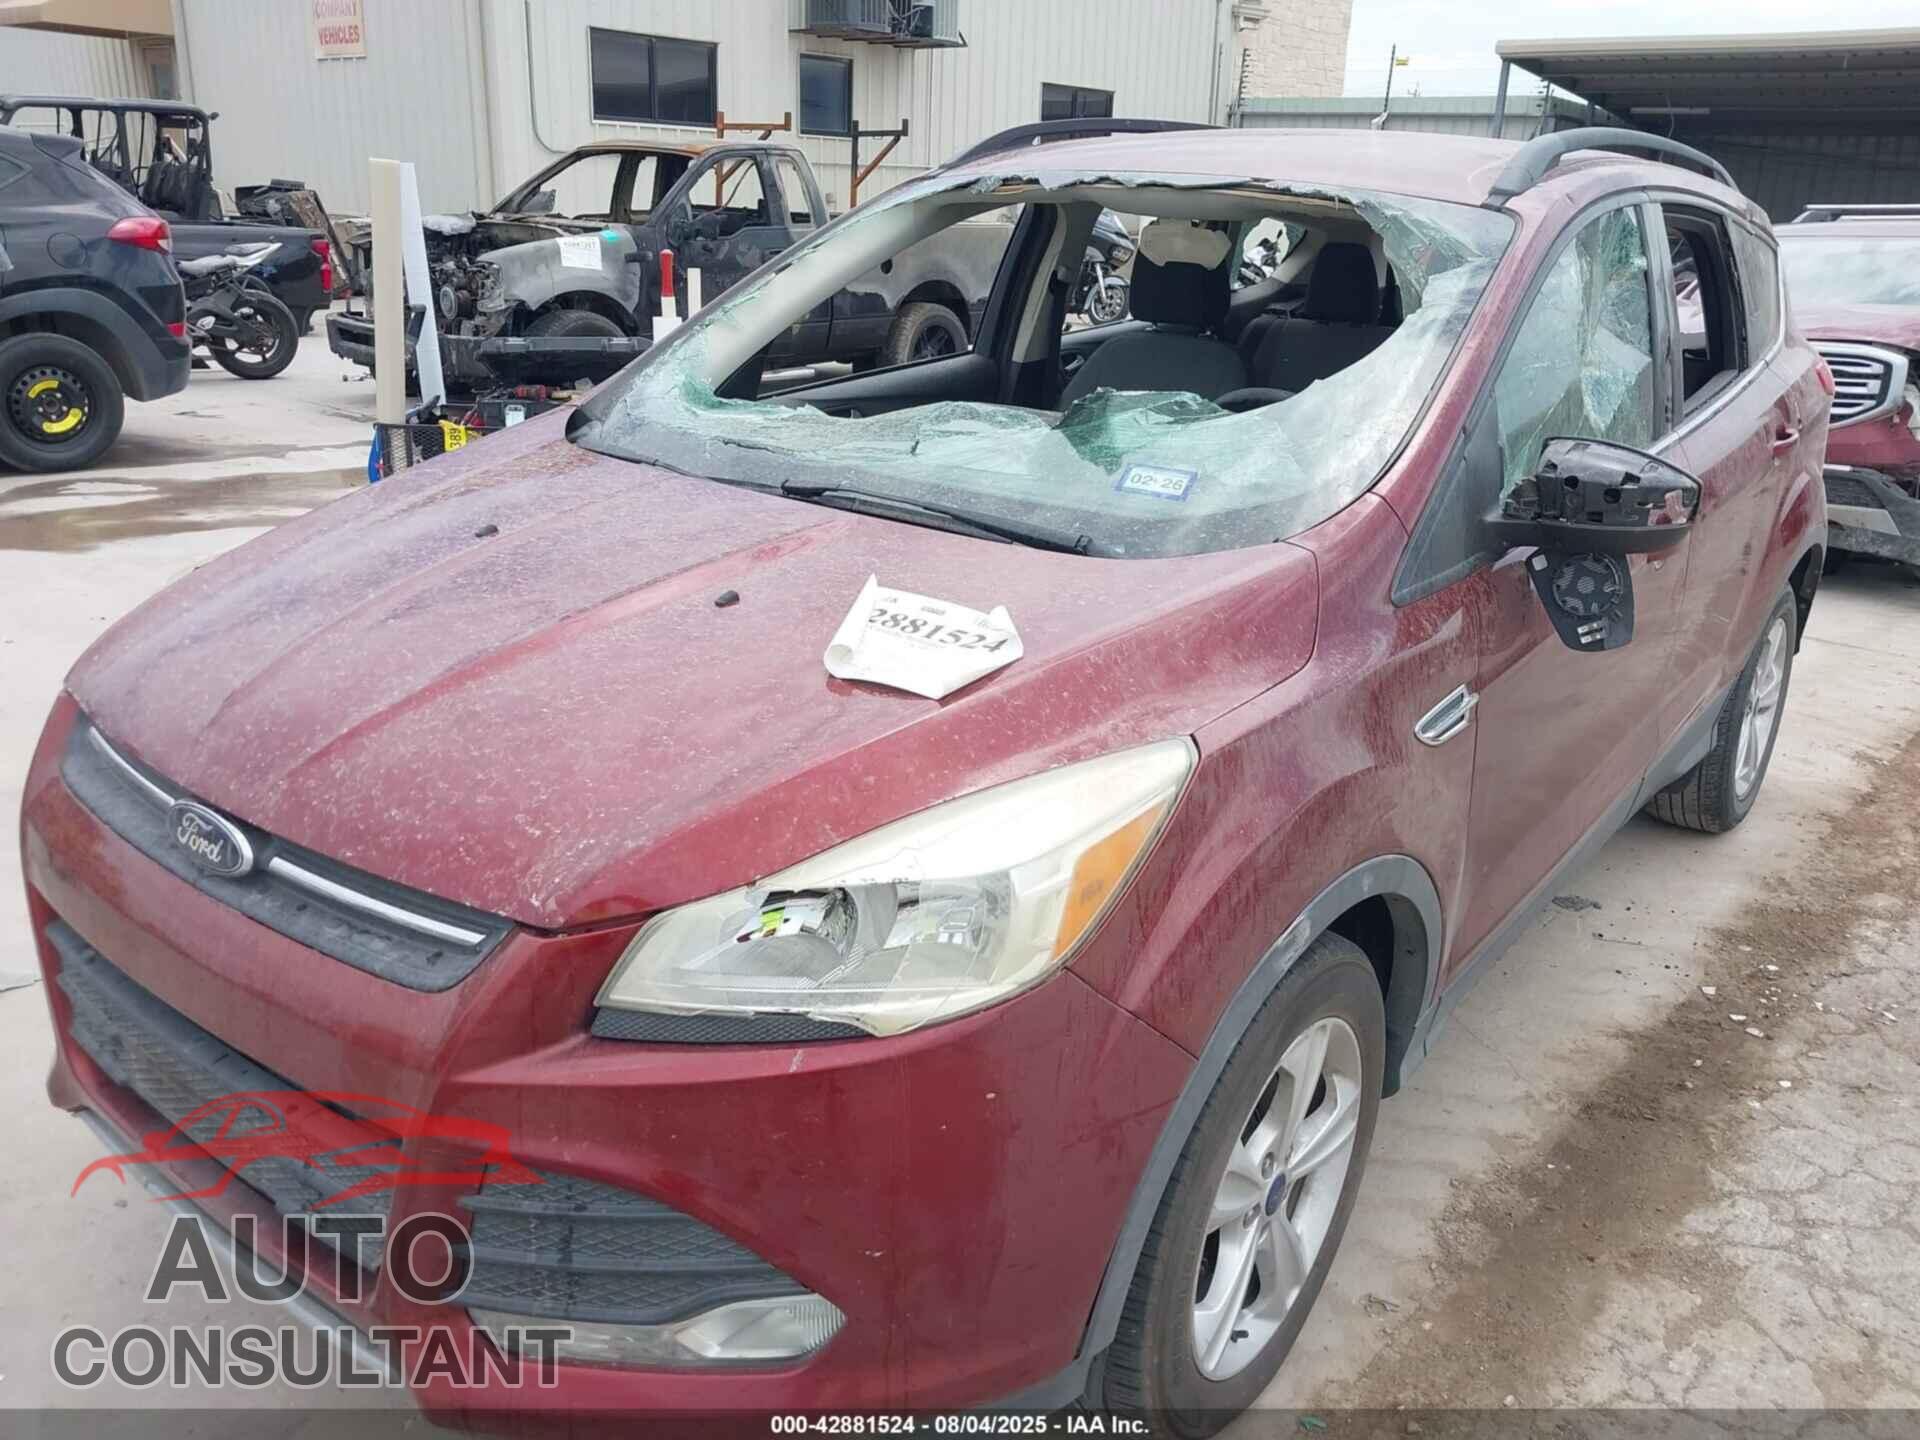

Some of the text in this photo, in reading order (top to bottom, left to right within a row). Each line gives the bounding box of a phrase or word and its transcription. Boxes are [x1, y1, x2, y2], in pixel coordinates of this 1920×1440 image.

[315, 0, 357, 18] COMPANY
[318, 25, 360, 46] VEHICLES
[1160, 478, 1184, 491] 26
[868, 608, 1009, 652] 2881524
[177, 812, 224, 863] Ford
